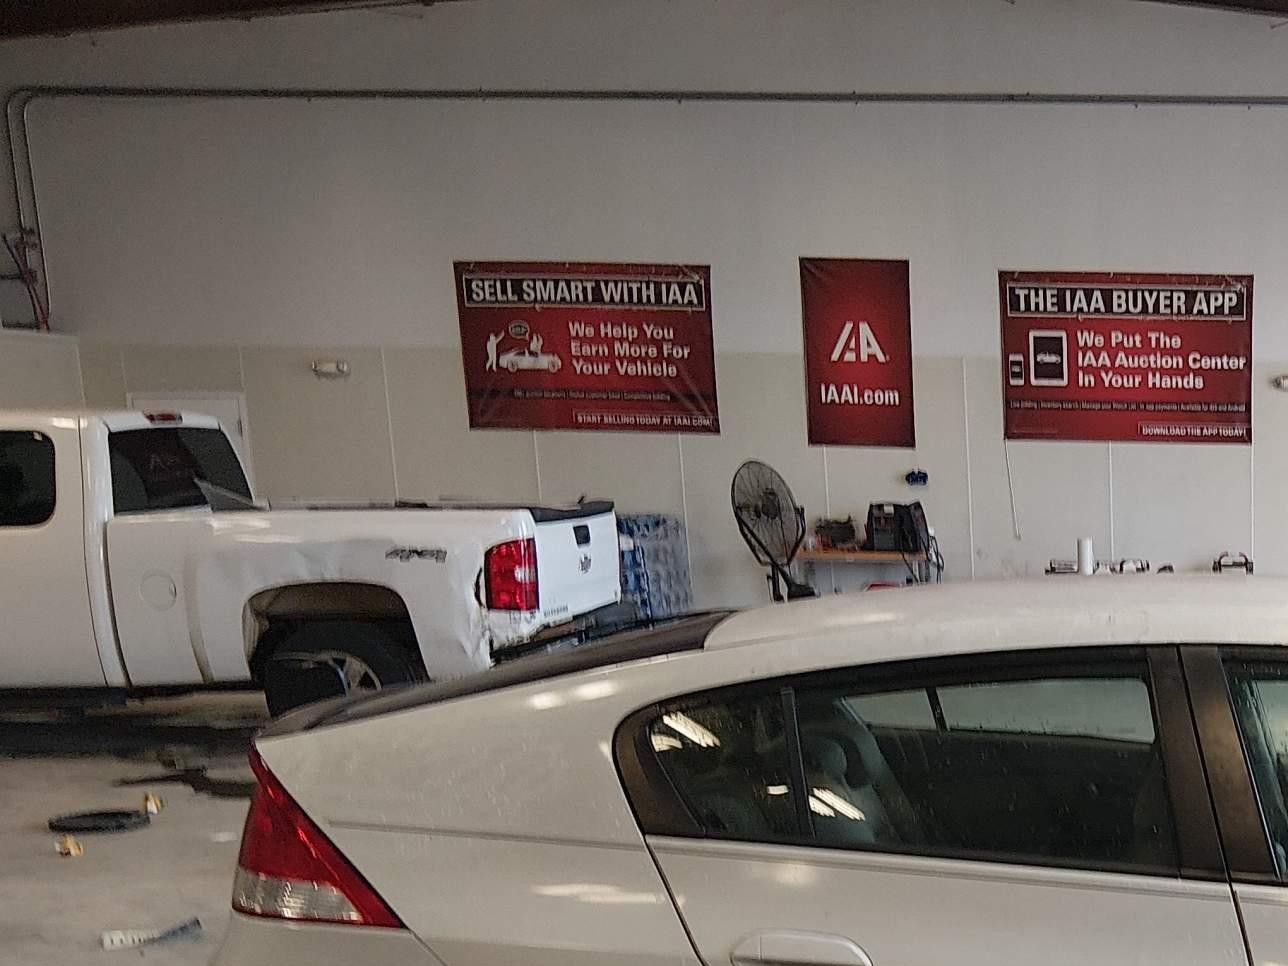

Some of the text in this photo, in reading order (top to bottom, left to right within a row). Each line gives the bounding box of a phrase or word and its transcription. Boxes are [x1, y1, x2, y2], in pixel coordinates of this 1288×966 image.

[472, 279, 698, 305] SELL SMART WITH IAA
[1014, 288, 1238, 315] THE IAA BUYER APP
[568, 321, 674, 342] We Help You
[1077, 330, 1182, 349] We Put The
[571, 340, 691, 359] Earn More For
[572, 359, 677, 378] Your Vehicle
[1077, 352, 1246, 370] IAA Auction Center
[1078, 371, 1204, 389] In Your Hands
[820, 383, 899, 406] IAAI.com
